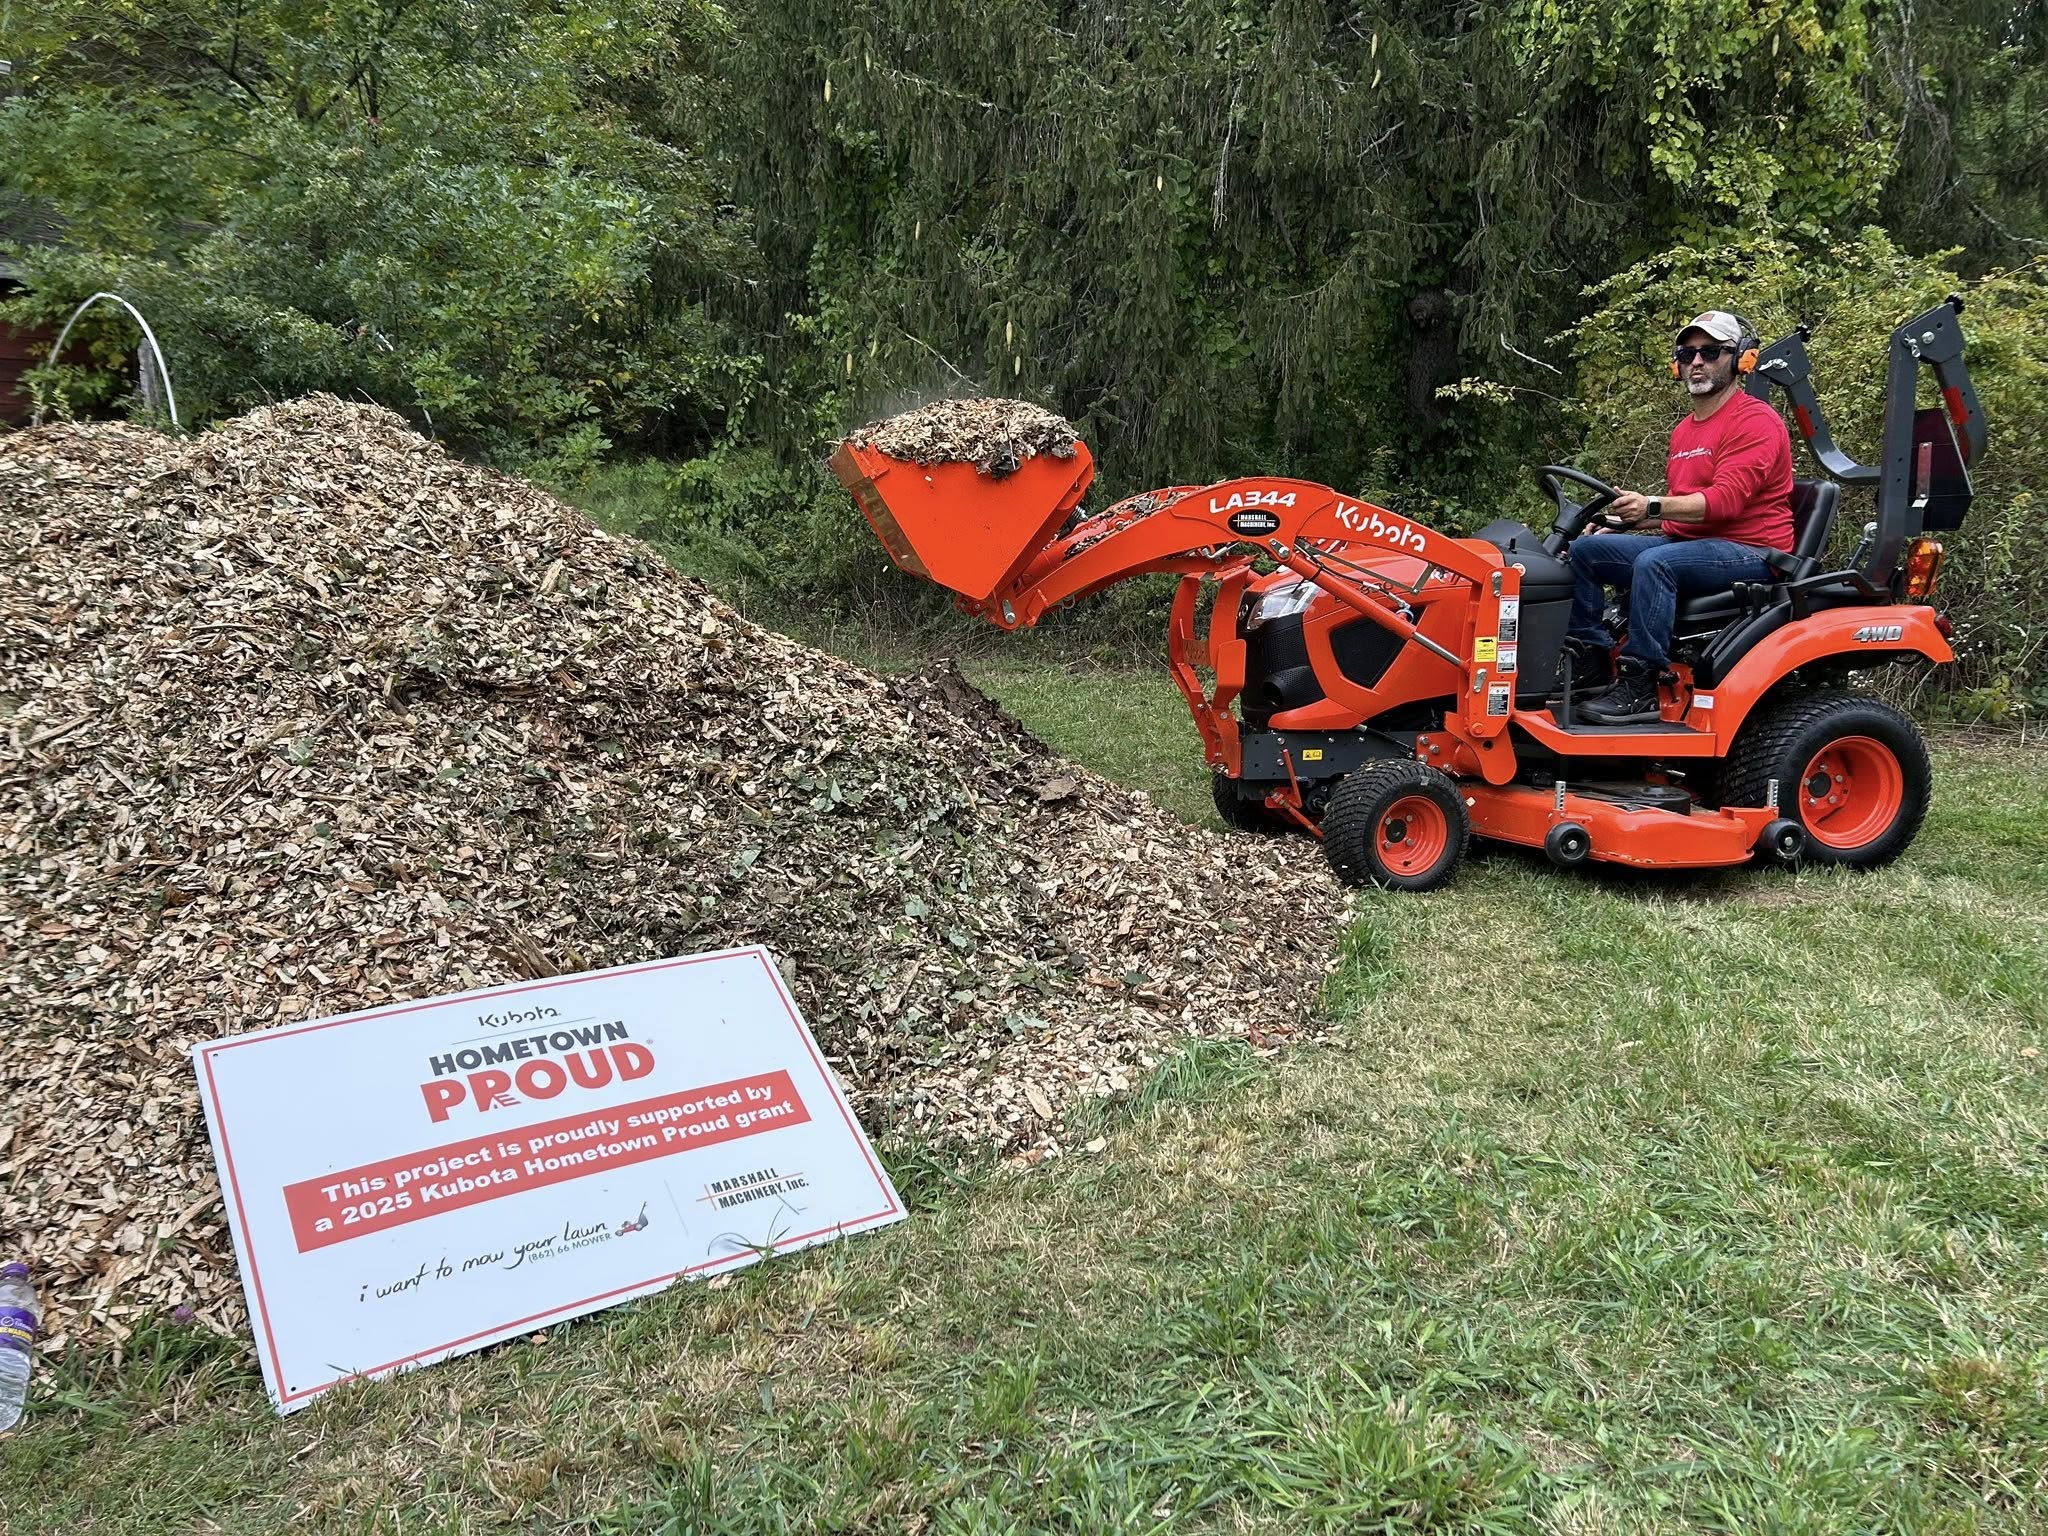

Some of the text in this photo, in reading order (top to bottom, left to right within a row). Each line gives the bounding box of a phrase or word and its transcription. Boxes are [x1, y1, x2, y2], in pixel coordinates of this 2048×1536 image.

[1209, 490, 1297, 514] LA344
[1335, 501, 1426, 553] Kubota
[1852, 625, 1903, 643] 4WD
[478, 1006, 560, 1027] Kubota
[429, 1020, 629, 1076] HOMETOWN
[420, 1042, 655, 1124] PROUD
[321, 1084, 773, 1203] This project is proudly supported by
[315, 1100, 794, 1232] a 2025 Kubota Hometown Proud grant
[711, 1168, 779, 1193] MARSHALL
[718, 1178, 810, 1209] MACHINERY, Inc.
[376, 1263, 430, 1298] want
[436, 1257, 453, 1279] to
[462, 1251, 504, 1272] mow
[503, 1235, 557, 1269] your
[563, 1222, 608, 1241] lawn
[528, 1232, 612, 1263] (862) 66 MOWER
